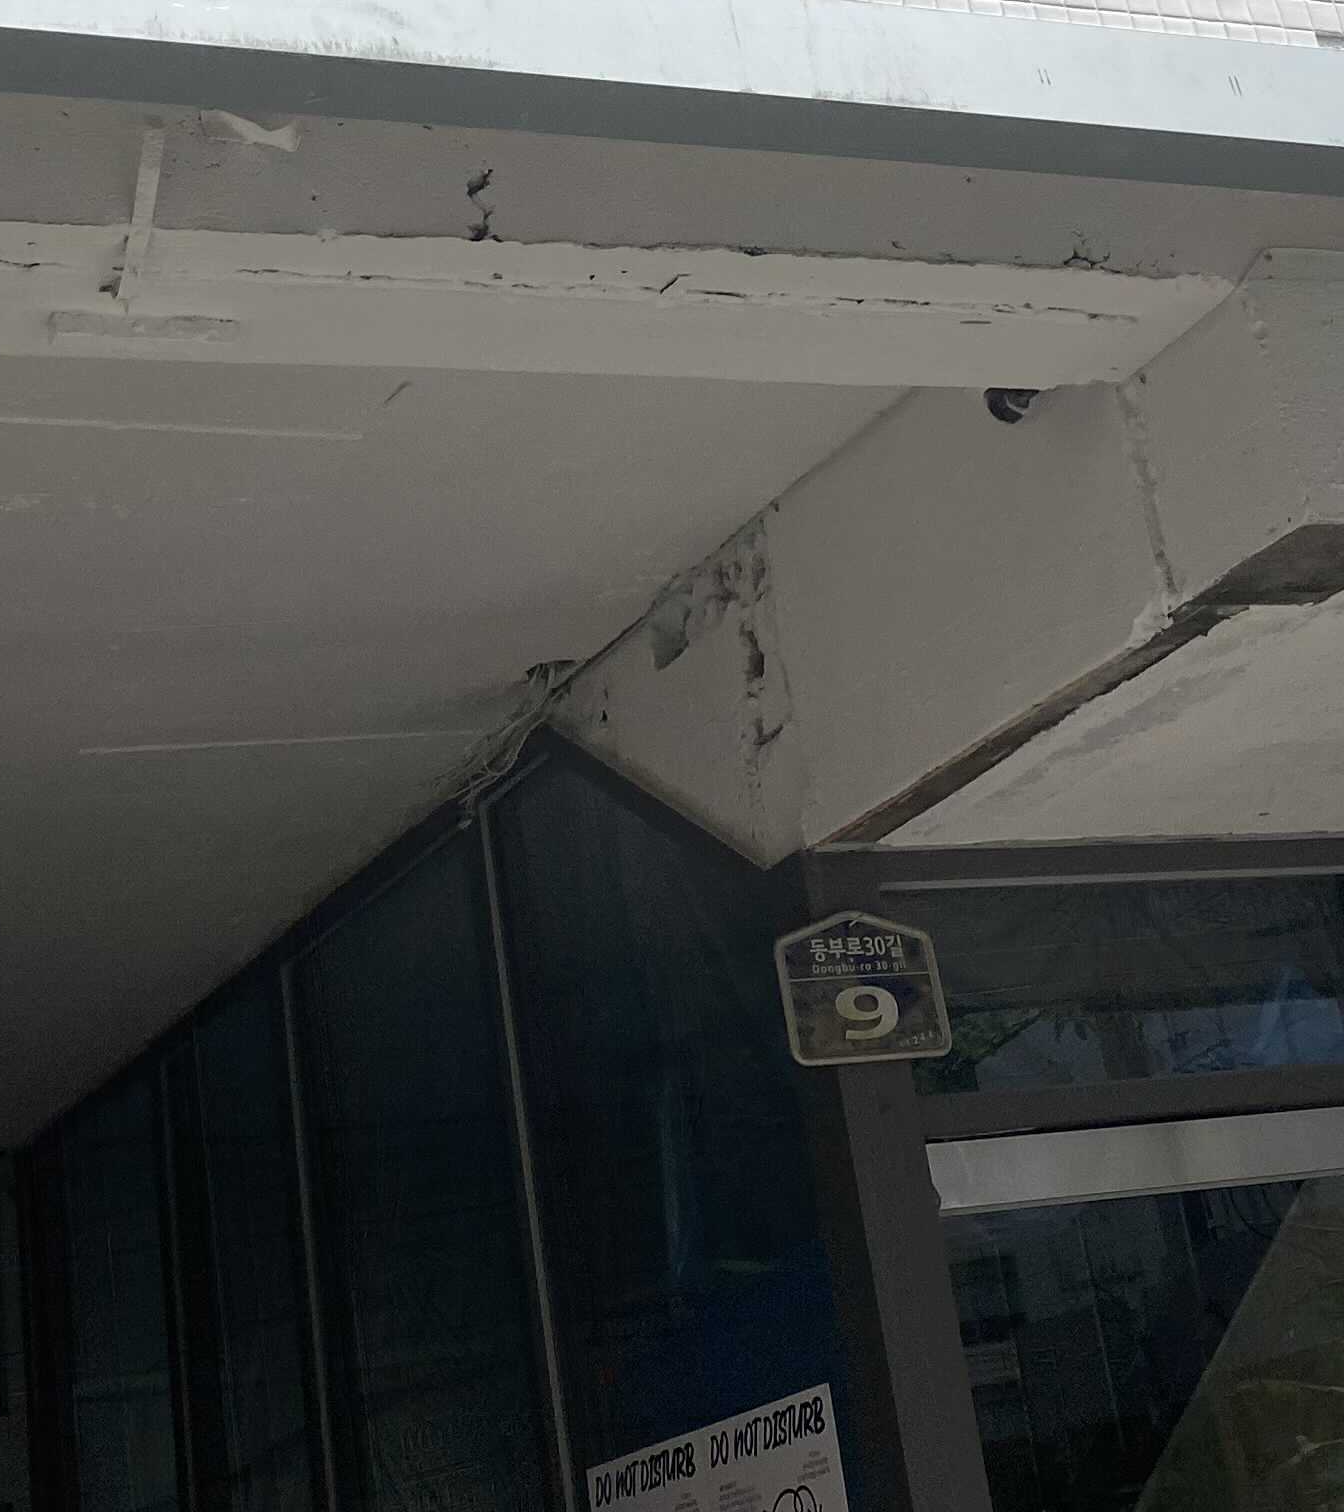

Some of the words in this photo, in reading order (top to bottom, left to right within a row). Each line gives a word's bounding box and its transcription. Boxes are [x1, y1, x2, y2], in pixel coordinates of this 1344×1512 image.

[835, 986, 900, 1041] 9
[710, 1431, 729, 1469] DO
[733, 1417, 762, 1461] NOT
[762, 1396, 826, 1451] DISTURB
[594, 1471, 612, 1507] DO
[615, 1460, 639, 1499] NOT
[640, 1442, 697, 1493] DISTURB
